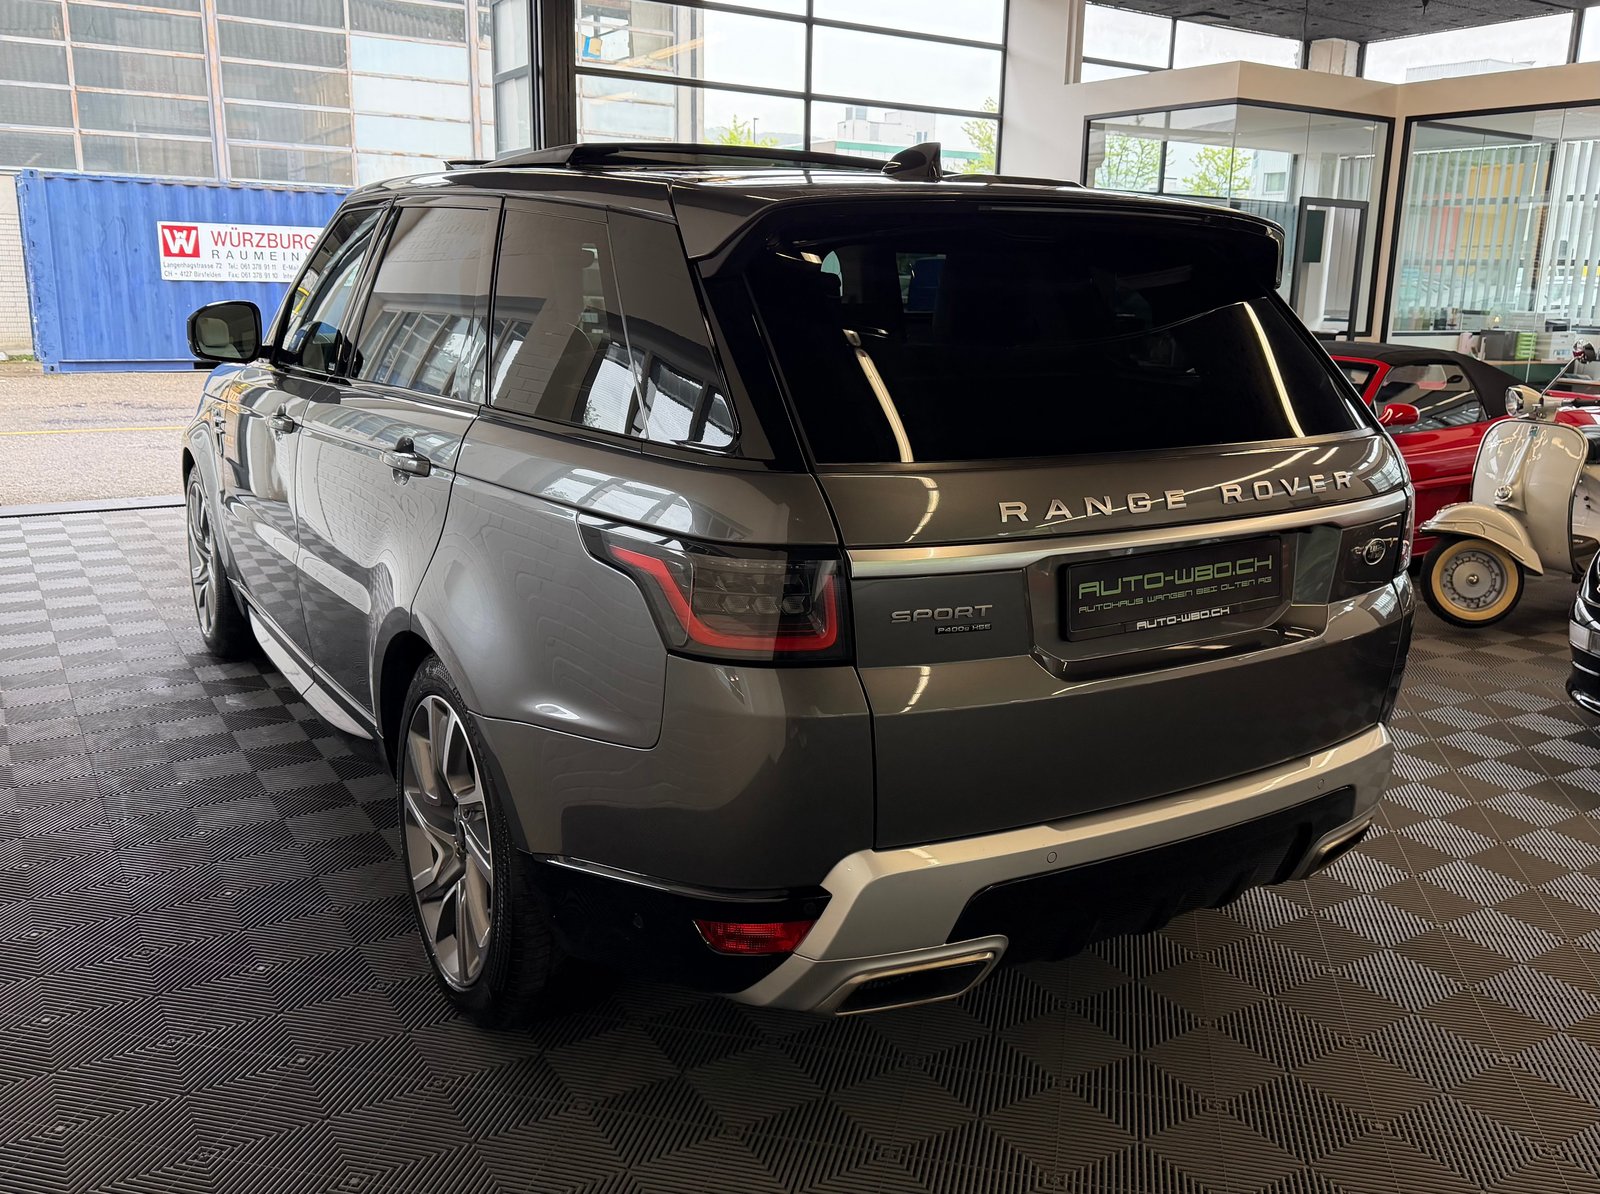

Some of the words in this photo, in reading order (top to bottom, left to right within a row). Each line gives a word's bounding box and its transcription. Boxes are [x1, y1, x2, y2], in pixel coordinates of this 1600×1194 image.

[211, 227, 319, 249] WÜRZBURG
[211, 249, 307, 261] RAUMEIN
[998, 488, 1187, 523] RANGE
[1220, 470, 1353, 505] ROVER
[1078, 555, 1273, 600] AUTO-WBO.CH
[1078, 597, 1144, 614] AUTOHAUS
[1147, 589, 1193, 603] WANGEN
[1196, 585, 1218, 595] BEI
[1220, 579, 1256, 591] OLTEN
[1258, 576, 1272, 585] AG
[891, 604, 993, 623] SPORT
[1136, 606, 1230, 631] AUTO-WBO.CH
[937, 625, 970, 634] P400e
[972, 623, 991, 631] HSE
